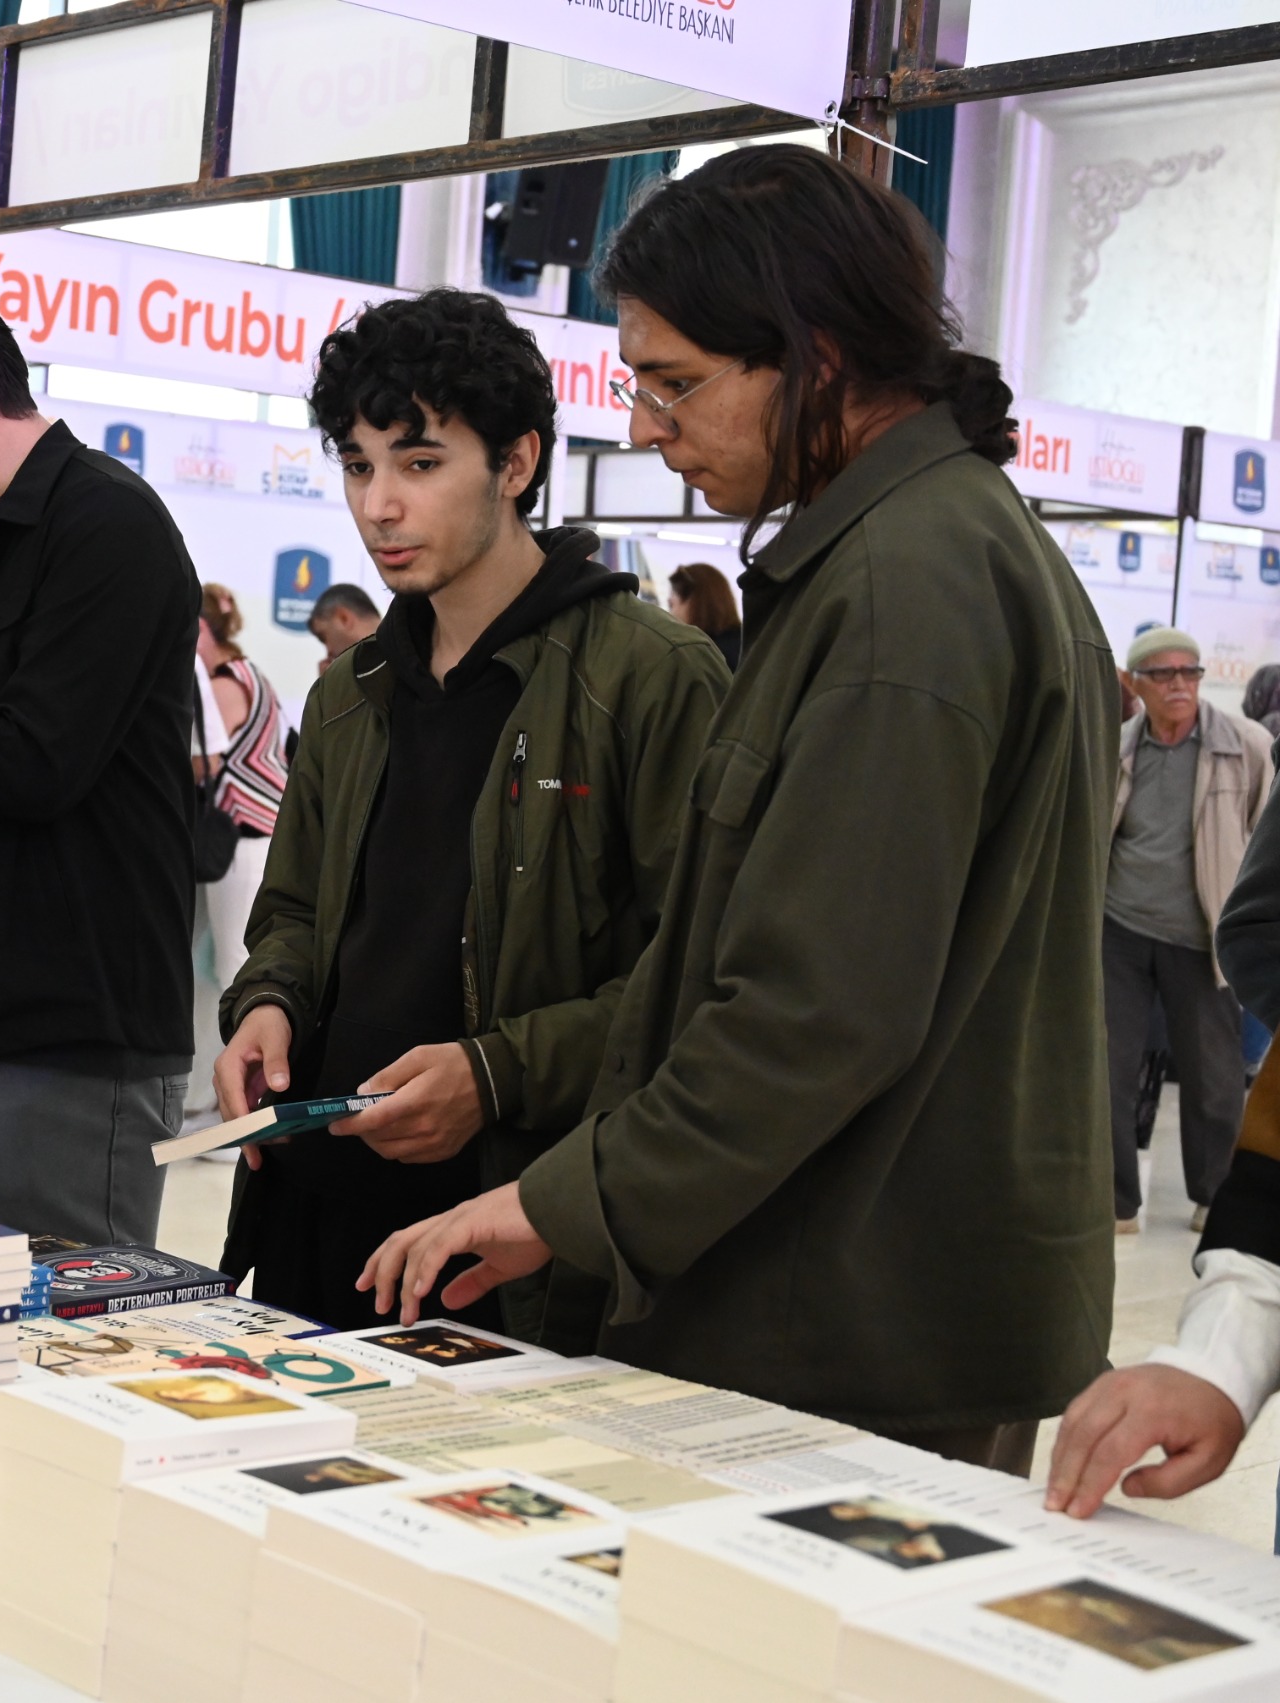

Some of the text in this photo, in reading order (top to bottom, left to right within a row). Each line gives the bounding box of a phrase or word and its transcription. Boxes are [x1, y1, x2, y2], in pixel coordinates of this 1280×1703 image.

[678, 11, 735, 45] BAŞKANI
[137, 278, 306, 364] Grubu
[108, 1291, 174, 1313] DEFTERİMDEN
[176, 1282, 226, 1300] PORTRELER
